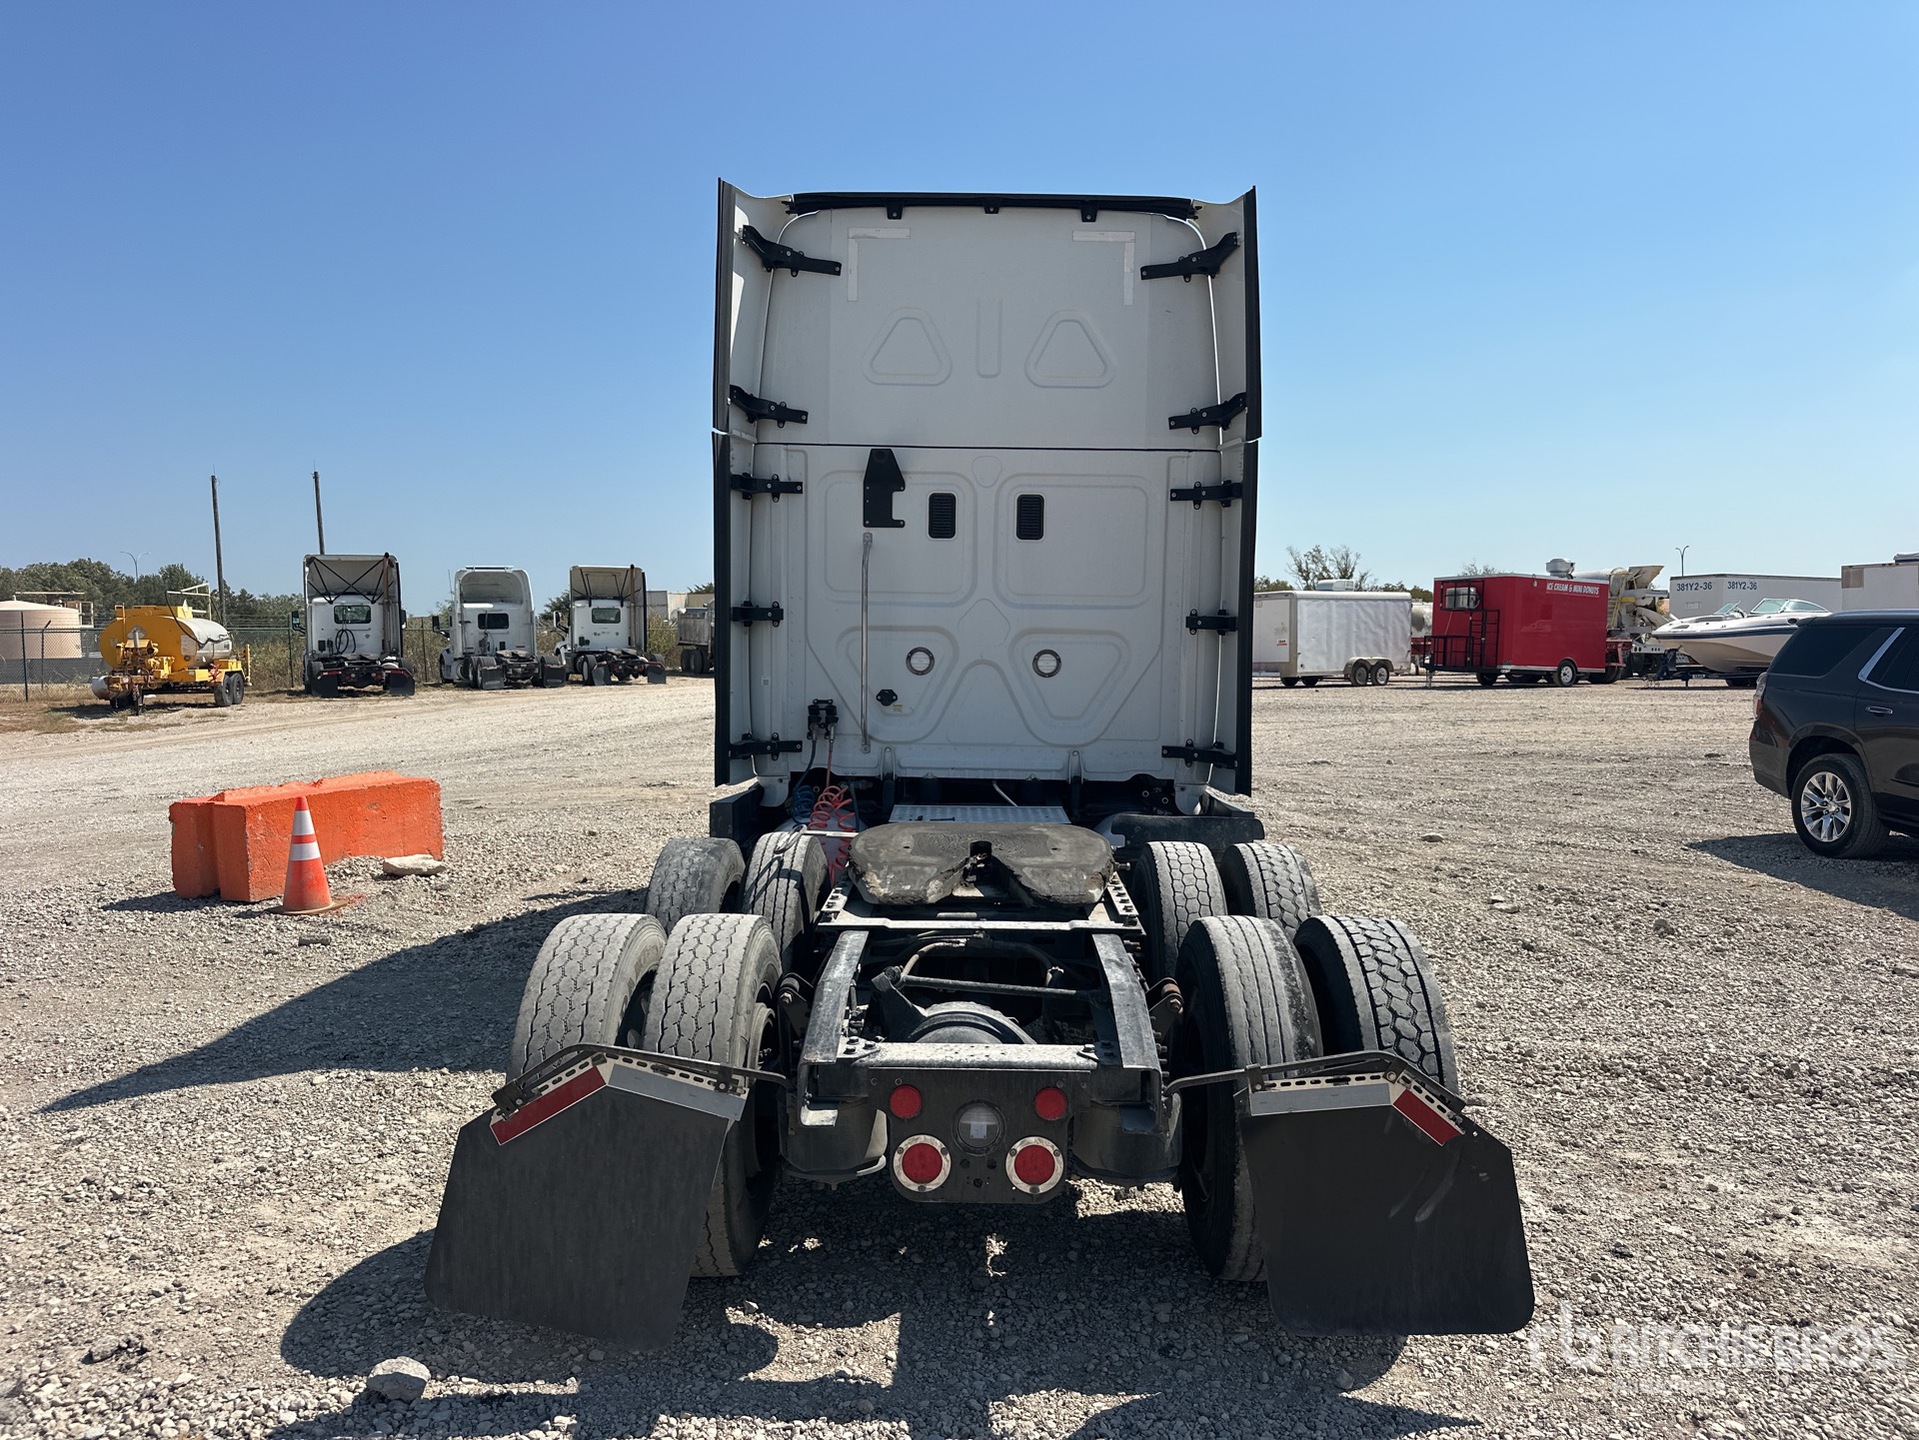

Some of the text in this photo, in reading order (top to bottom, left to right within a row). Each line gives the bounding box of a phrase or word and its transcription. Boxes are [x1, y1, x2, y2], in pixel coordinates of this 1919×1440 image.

[1554, 583, 1568, 592] CREAM
[1583, 586, 1600, 595] DONUTS
[1676, 581, 1713, 592] 381Y2-36
[1727, 581, 1758, 591] 381Y2-36
